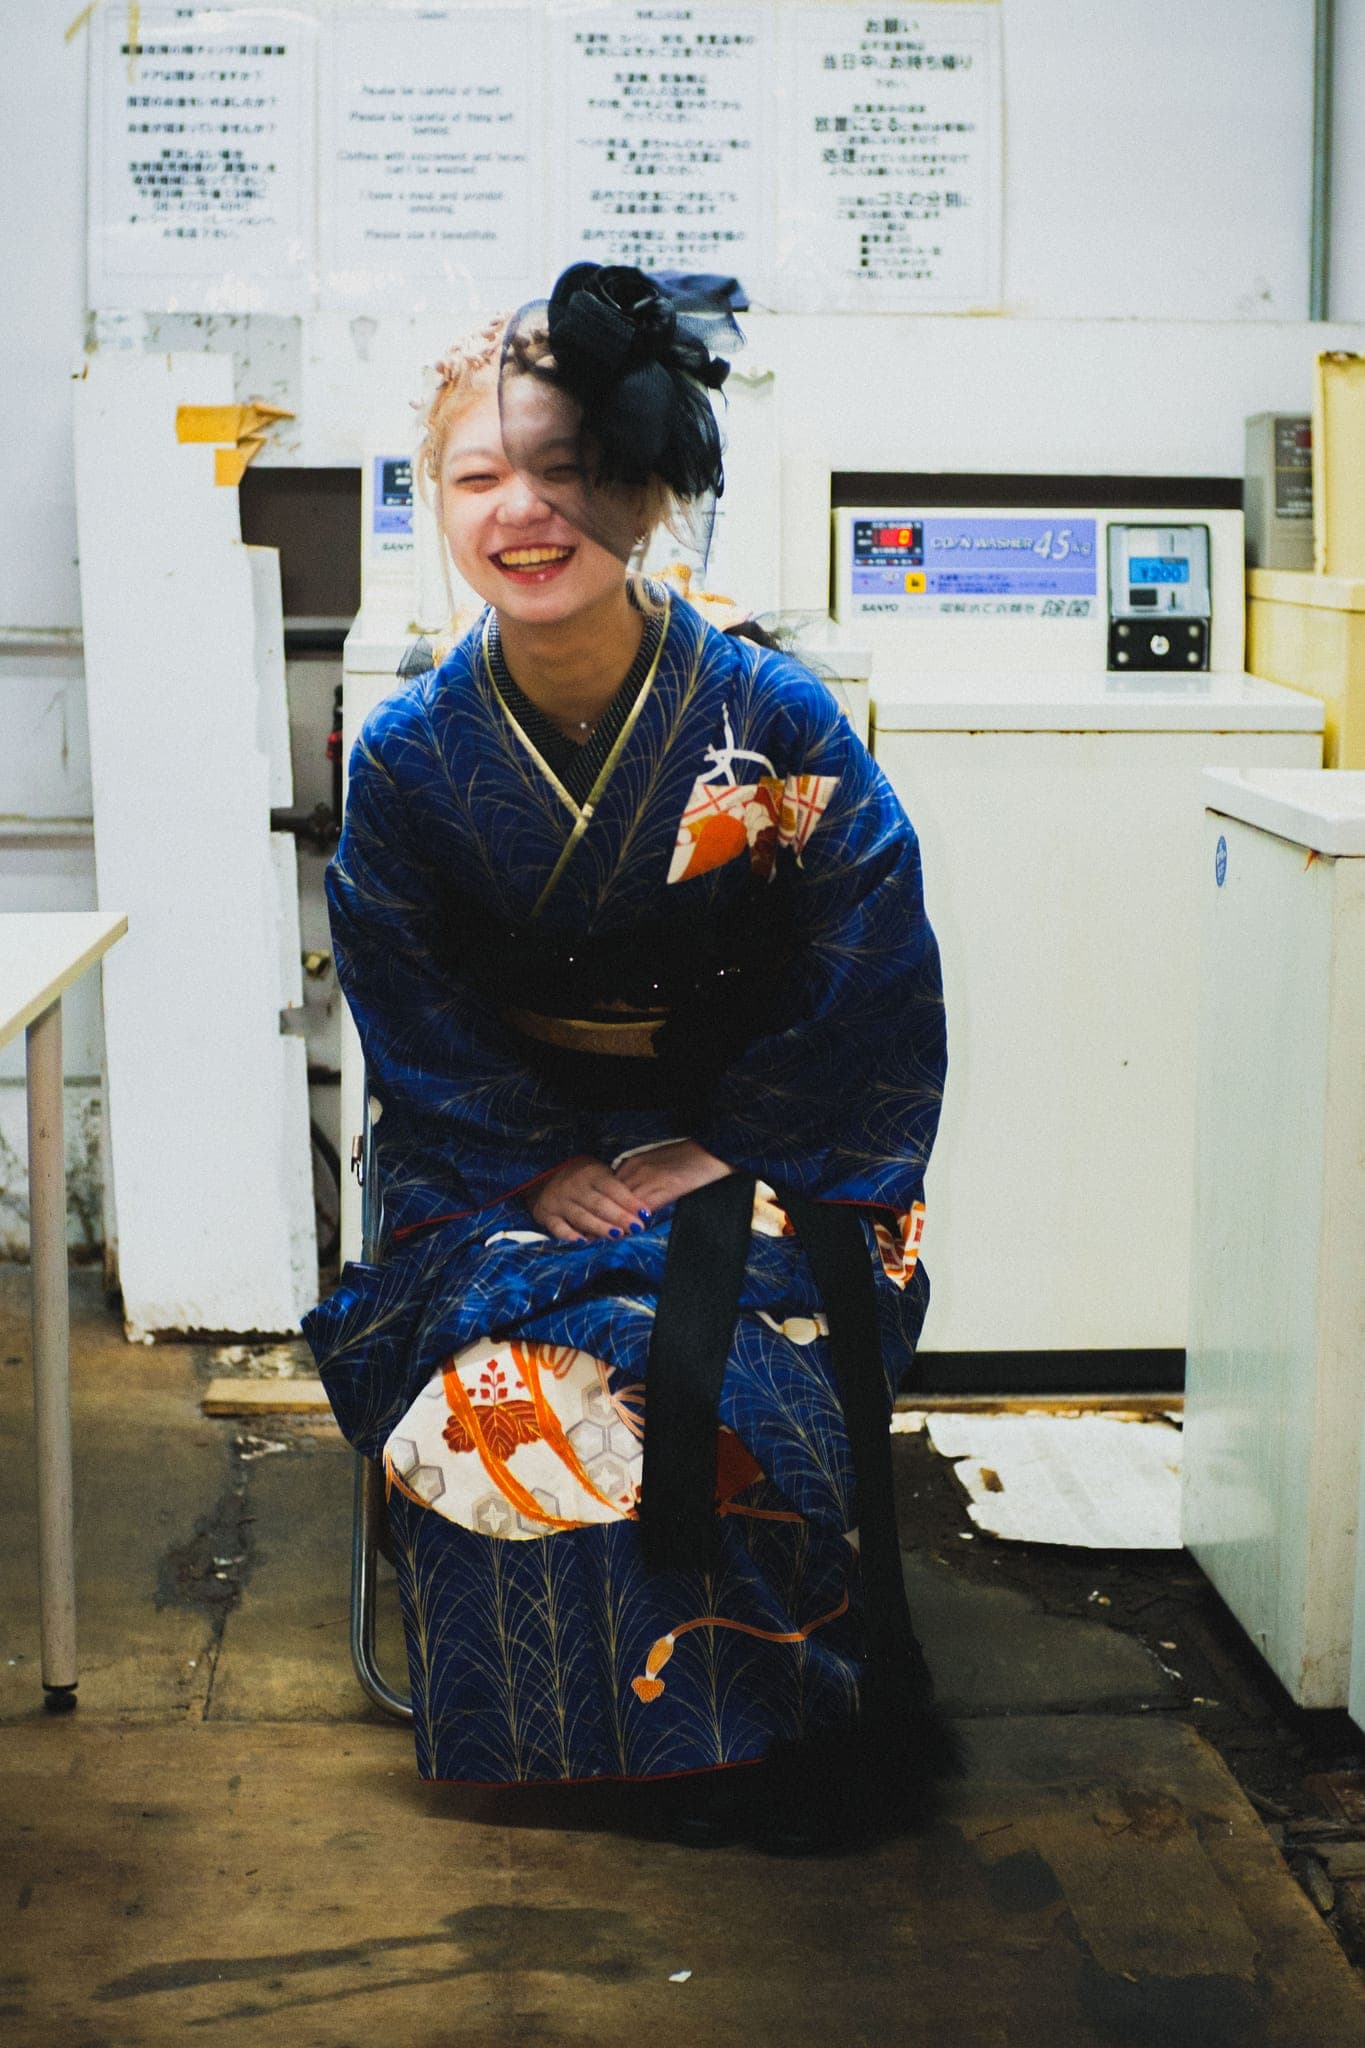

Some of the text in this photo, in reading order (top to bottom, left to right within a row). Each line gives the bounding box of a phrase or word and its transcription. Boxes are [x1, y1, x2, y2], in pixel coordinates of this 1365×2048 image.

[866, 19, 919, 34] お願い
[823, 54, 973, 70] 当日中にお持ち帰り
[976, 537, 1033, 550] WASHER
[861, 603, 899, 612] SANYO
